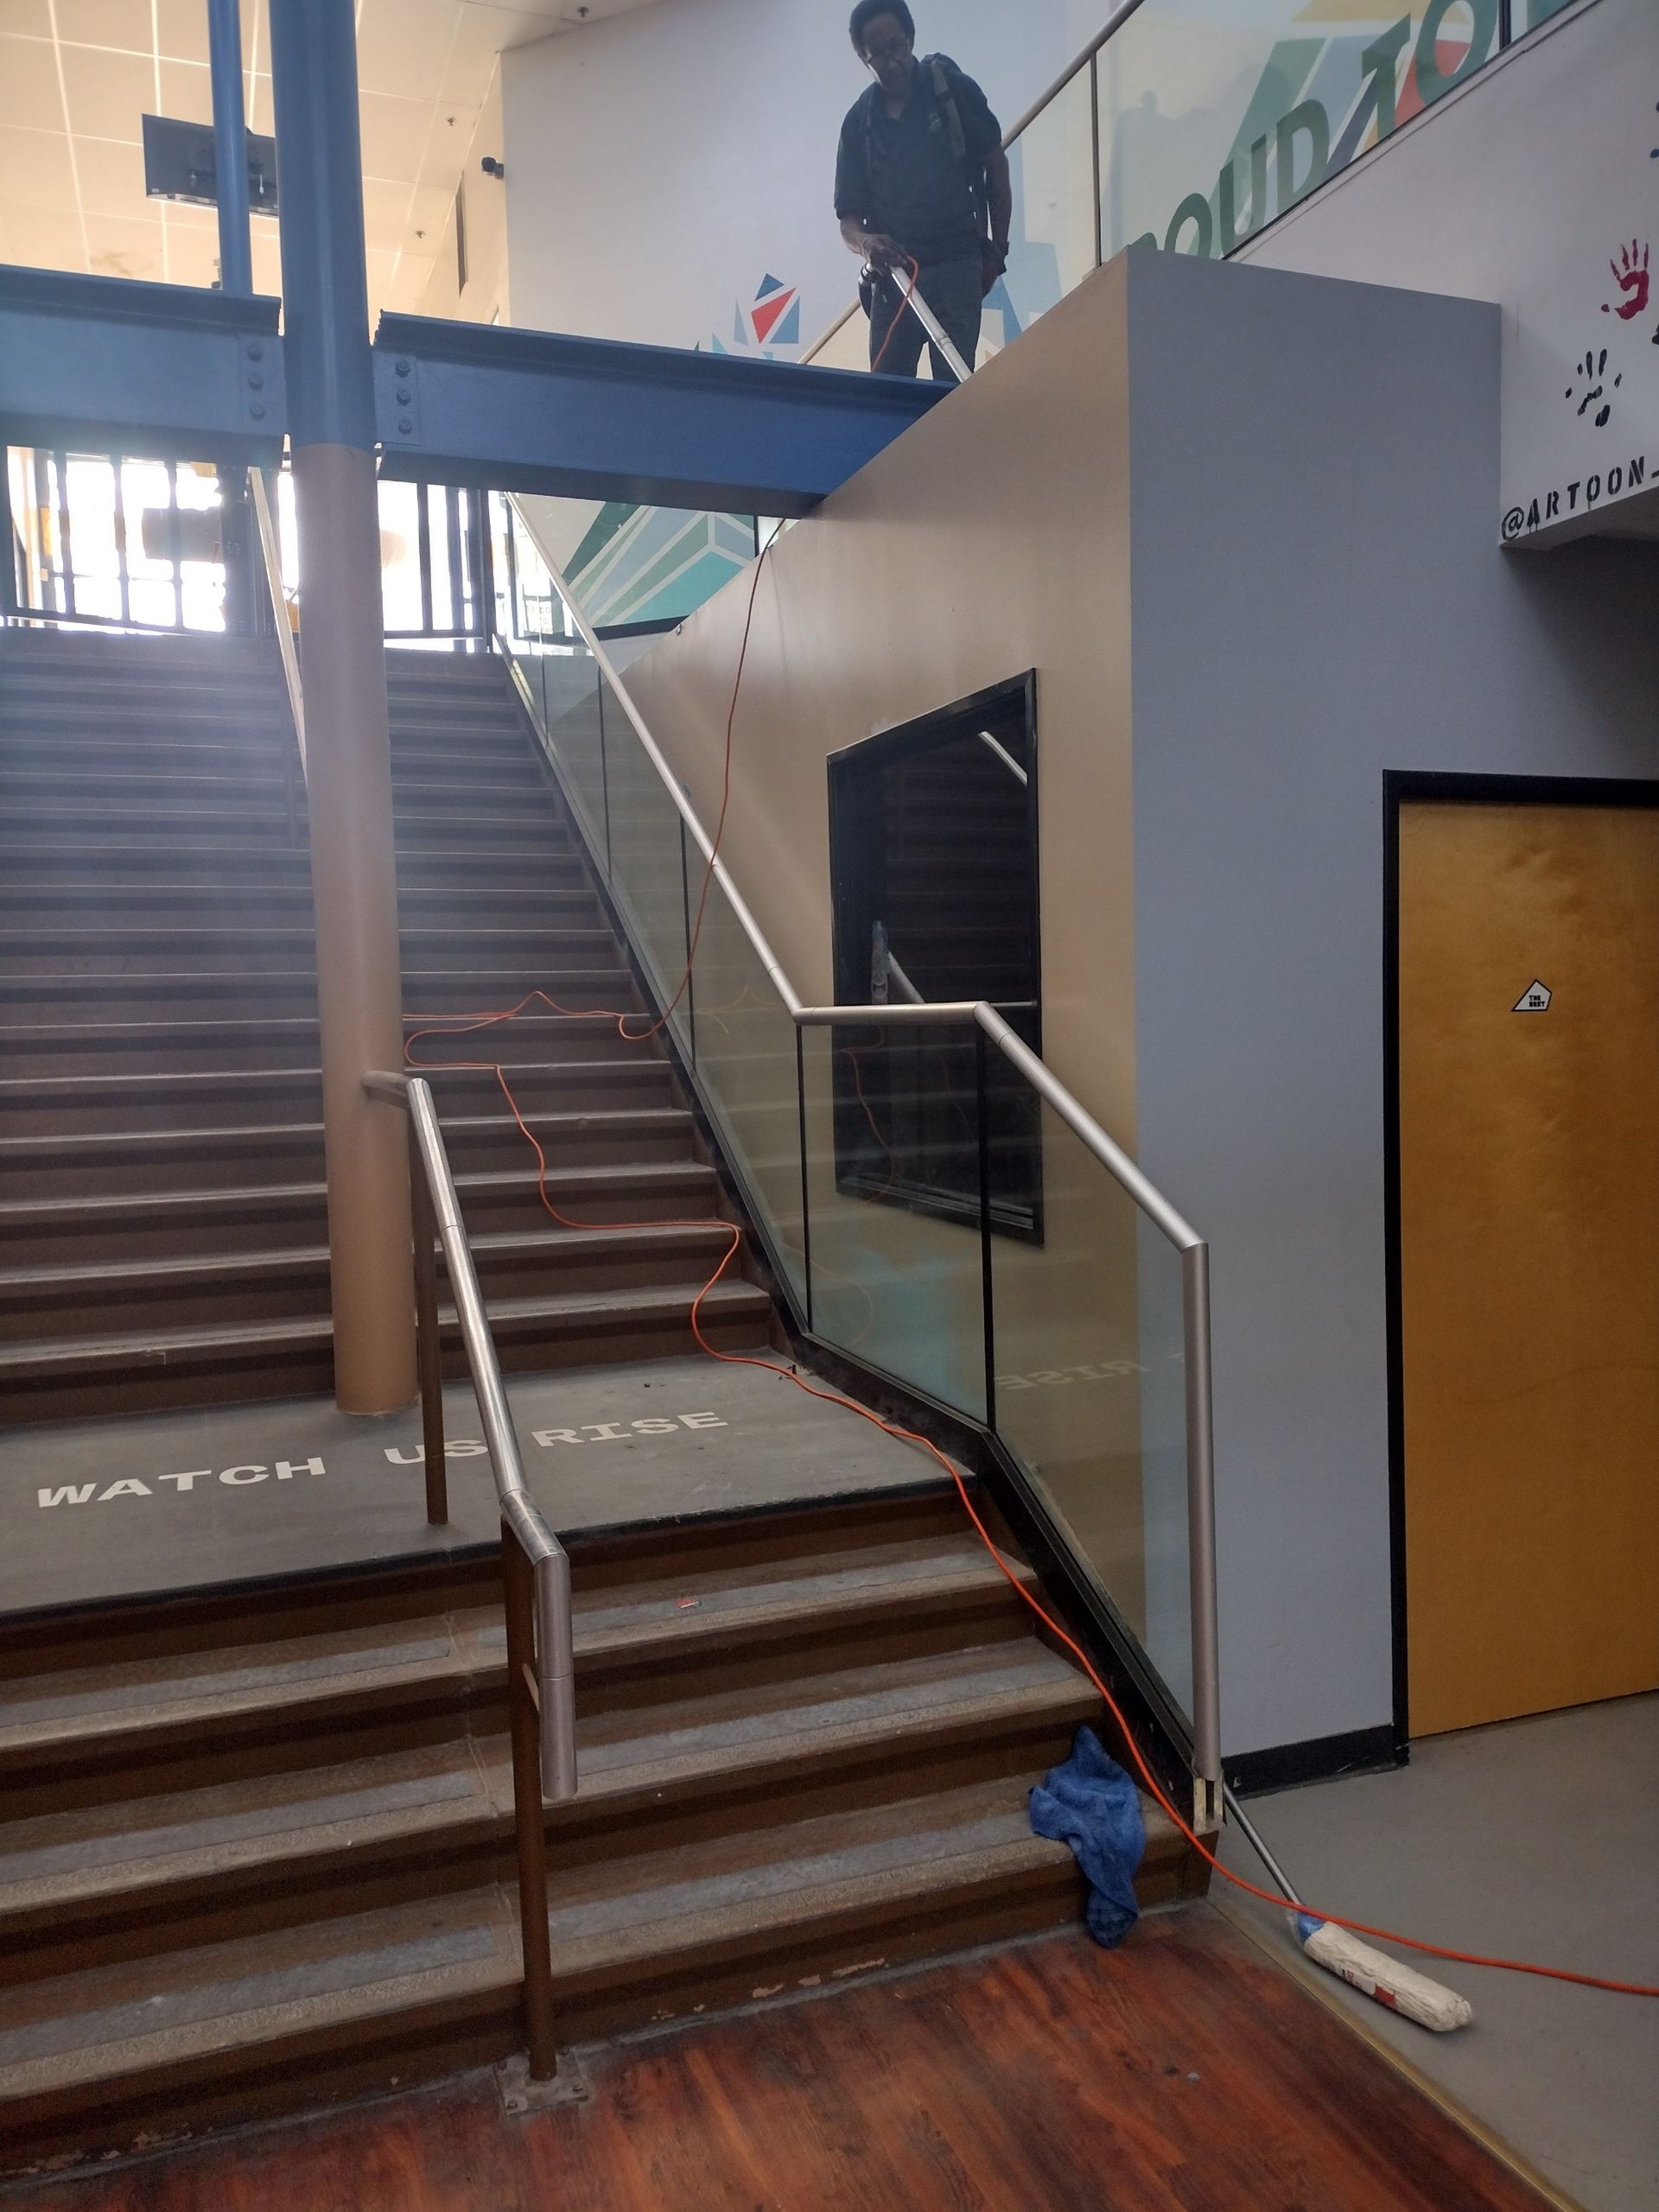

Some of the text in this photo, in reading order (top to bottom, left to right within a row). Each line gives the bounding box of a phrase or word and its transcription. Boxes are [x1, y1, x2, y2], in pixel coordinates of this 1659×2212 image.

[37, 1411, 729, 1508] WATCH US RISE
